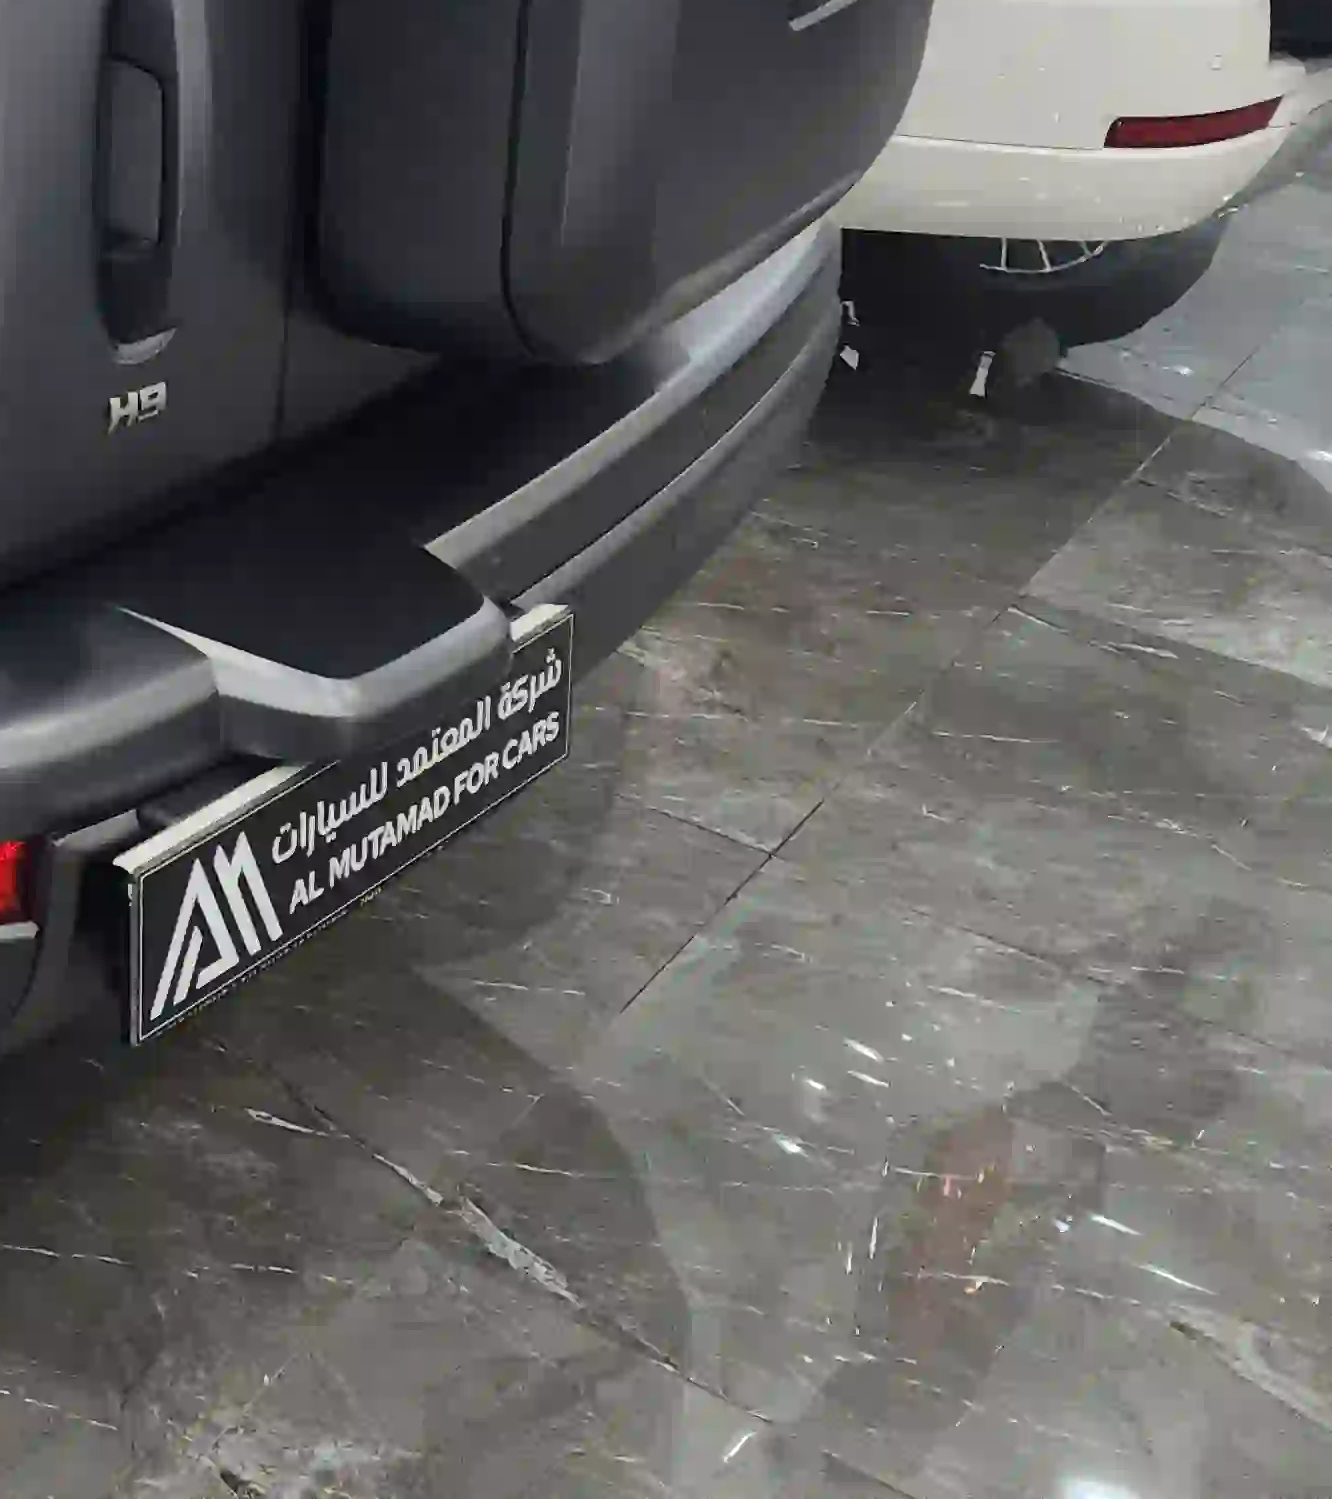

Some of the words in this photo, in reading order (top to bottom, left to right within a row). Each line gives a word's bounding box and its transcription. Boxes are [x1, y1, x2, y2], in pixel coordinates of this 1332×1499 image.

[108, 381, 167, 435] H9
[497, 647, 563, 721] شركة
[396, 695, 492, 788] المعتمد
[271, 761, 388, 864] للسيارات
[289, 870, 325, 915] AL
[328, 785, 452, 888] MUTAMAD
[453, 752, 500, 805] FOR
[501, 710, 561, 771] CARS
